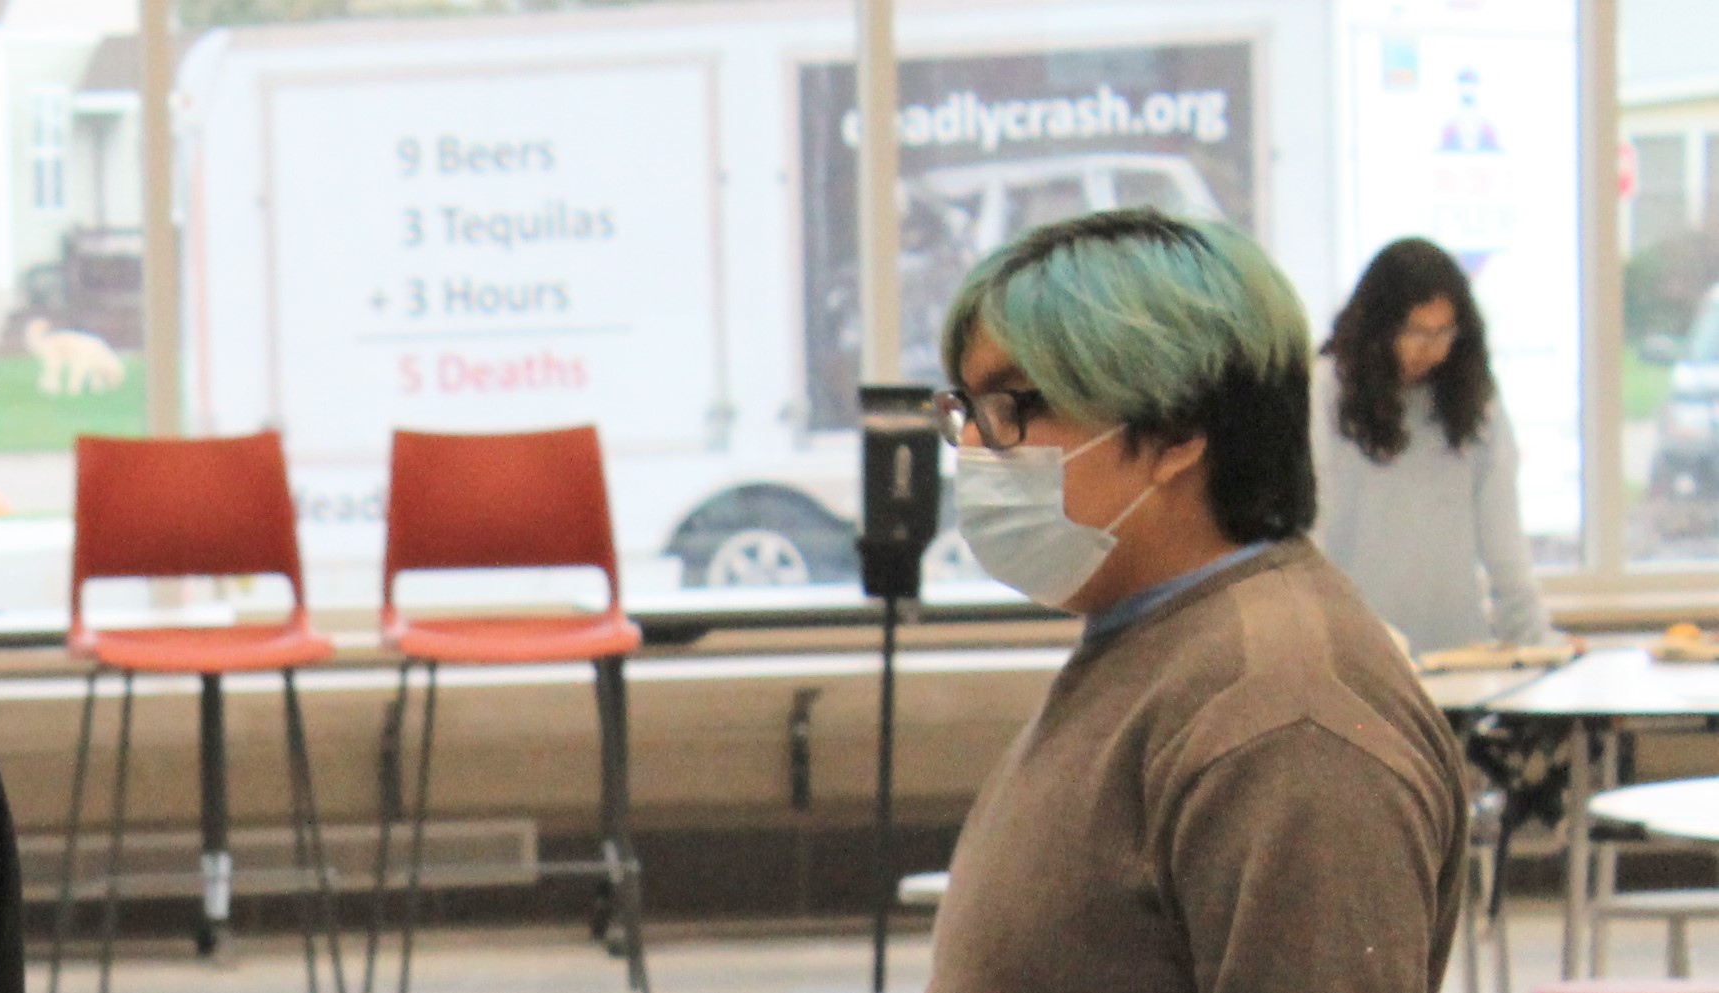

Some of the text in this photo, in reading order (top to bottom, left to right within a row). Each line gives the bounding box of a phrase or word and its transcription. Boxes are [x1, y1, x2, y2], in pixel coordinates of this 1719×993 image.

[397, 133, 556, 176] 9 Beers
[402, 199, 616, 251] 3 Tequilas
[408, 275, 428, 317] 3
[443, 274, 571, 315] Hours
[398, 350, 588, 396] 5 Deaths
